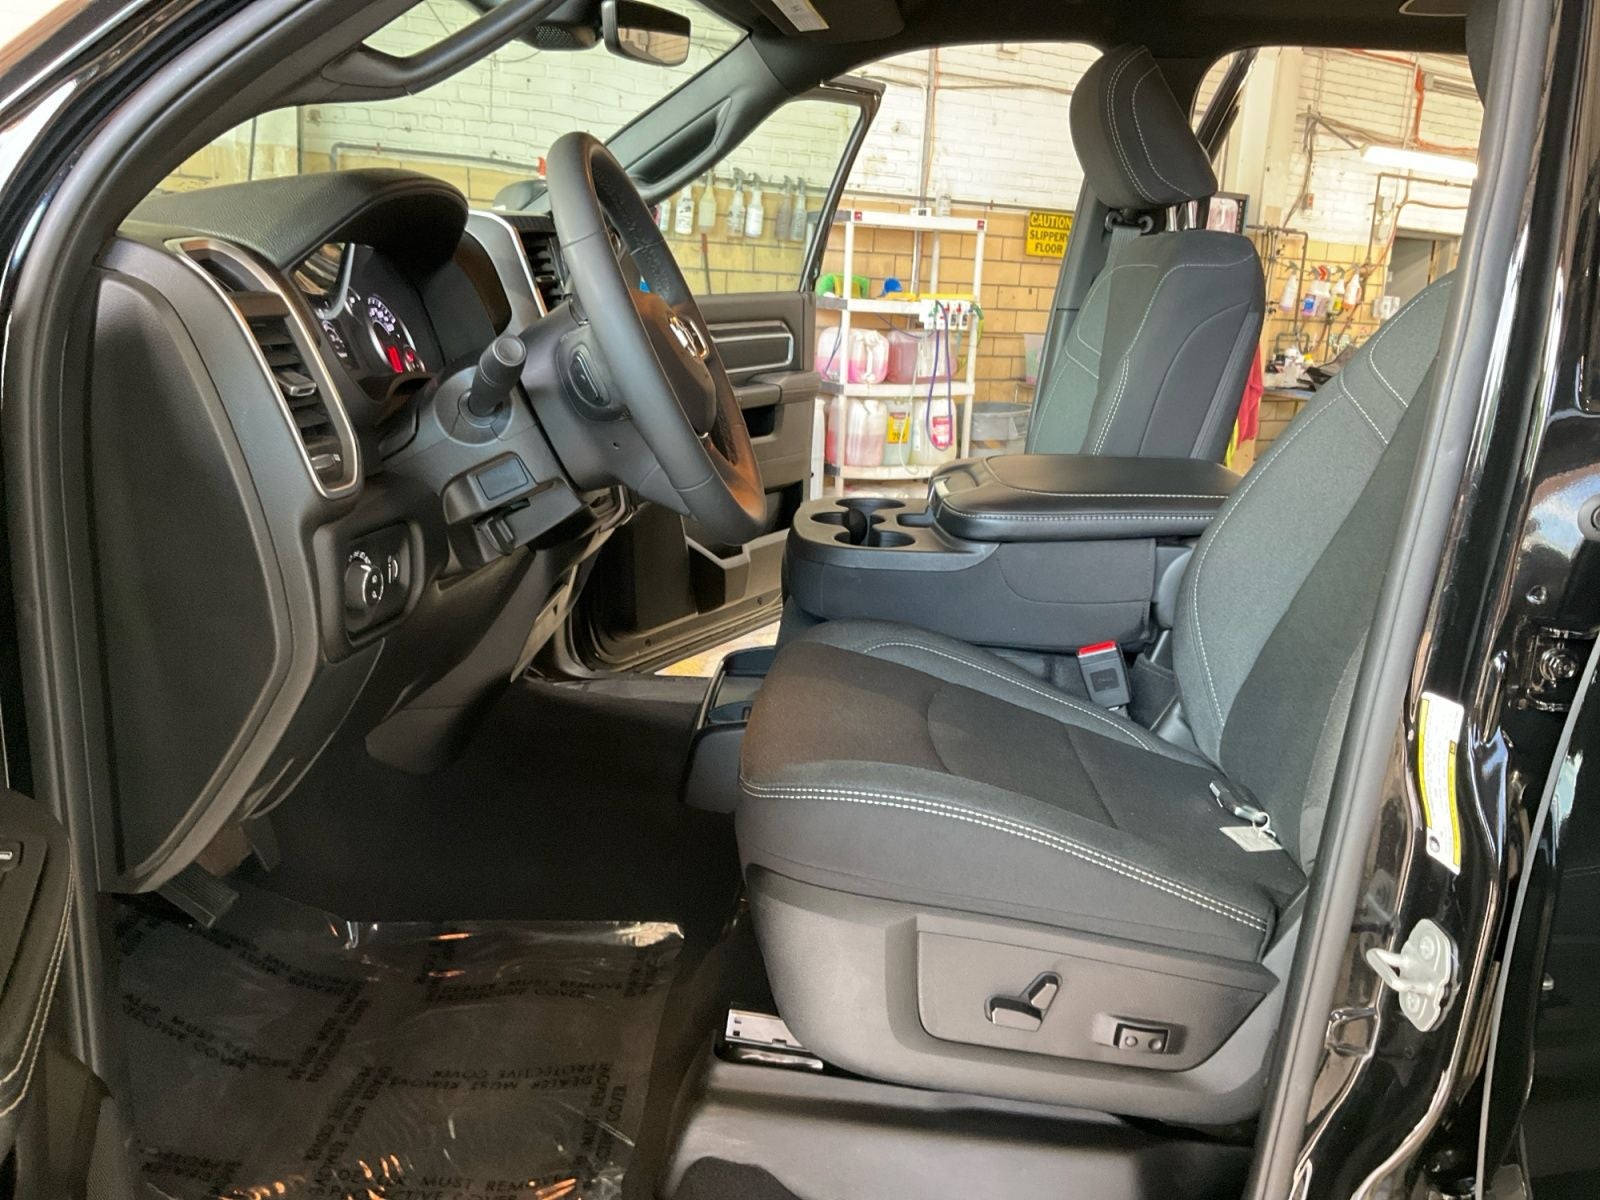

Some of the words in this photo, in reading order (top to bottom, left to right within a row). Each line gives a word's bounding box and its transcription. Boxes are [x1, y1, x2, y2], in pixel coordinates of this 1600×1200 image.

[1030, 213, 1072, 229] CAUTION
[1035, 242, 1063, 254] FLOOR
[420, 1176, 474, 1190] MUST
